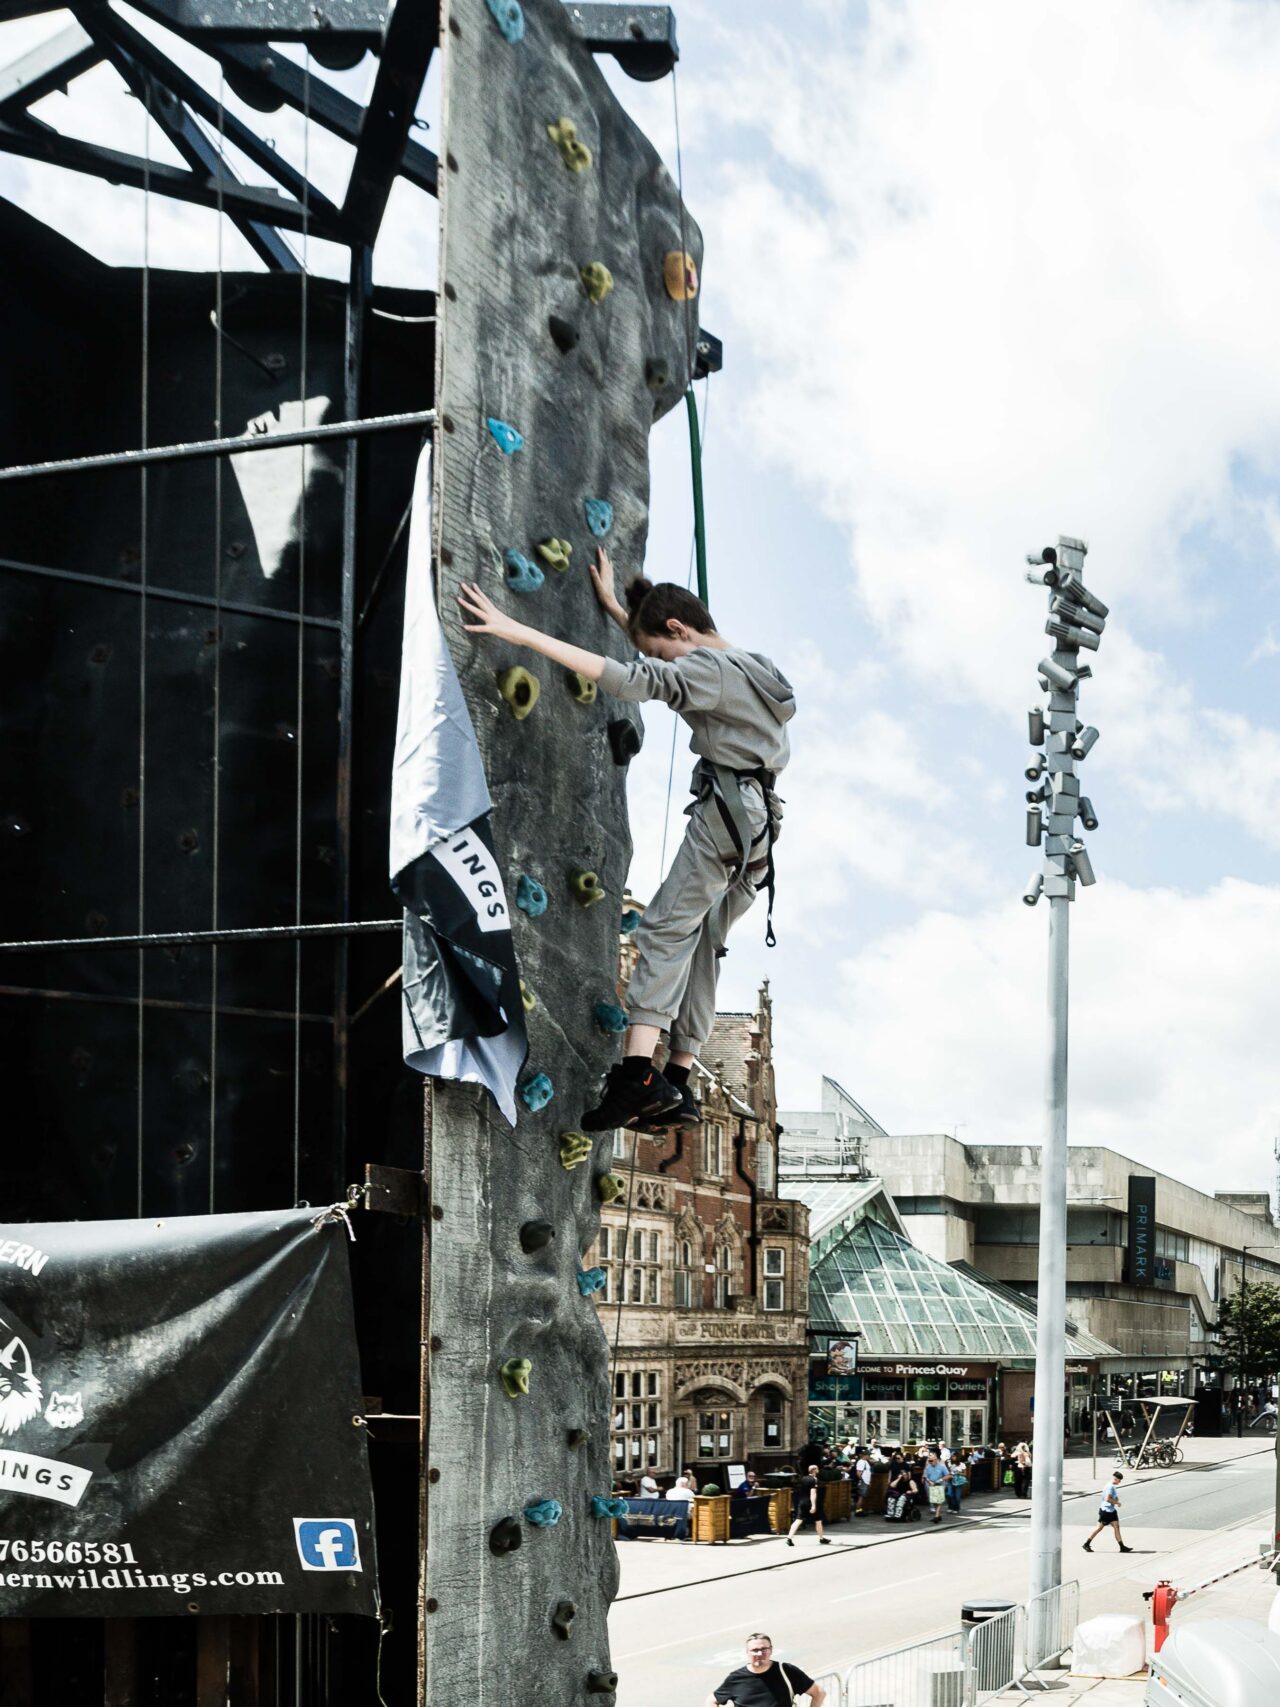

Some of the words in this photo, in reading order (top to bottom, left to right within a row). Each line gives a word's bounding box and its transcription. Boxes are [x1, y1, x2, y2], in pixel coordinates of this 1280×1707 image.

[452, 840, 505, 918] INGS
[1136, 1204, 1148, 1278] PRIMARK
[865, 1381, 903, 1392] Leisure
[1, 1459, 74, 1492] INGS
[0, 1539, 139, 1565] 76566581
